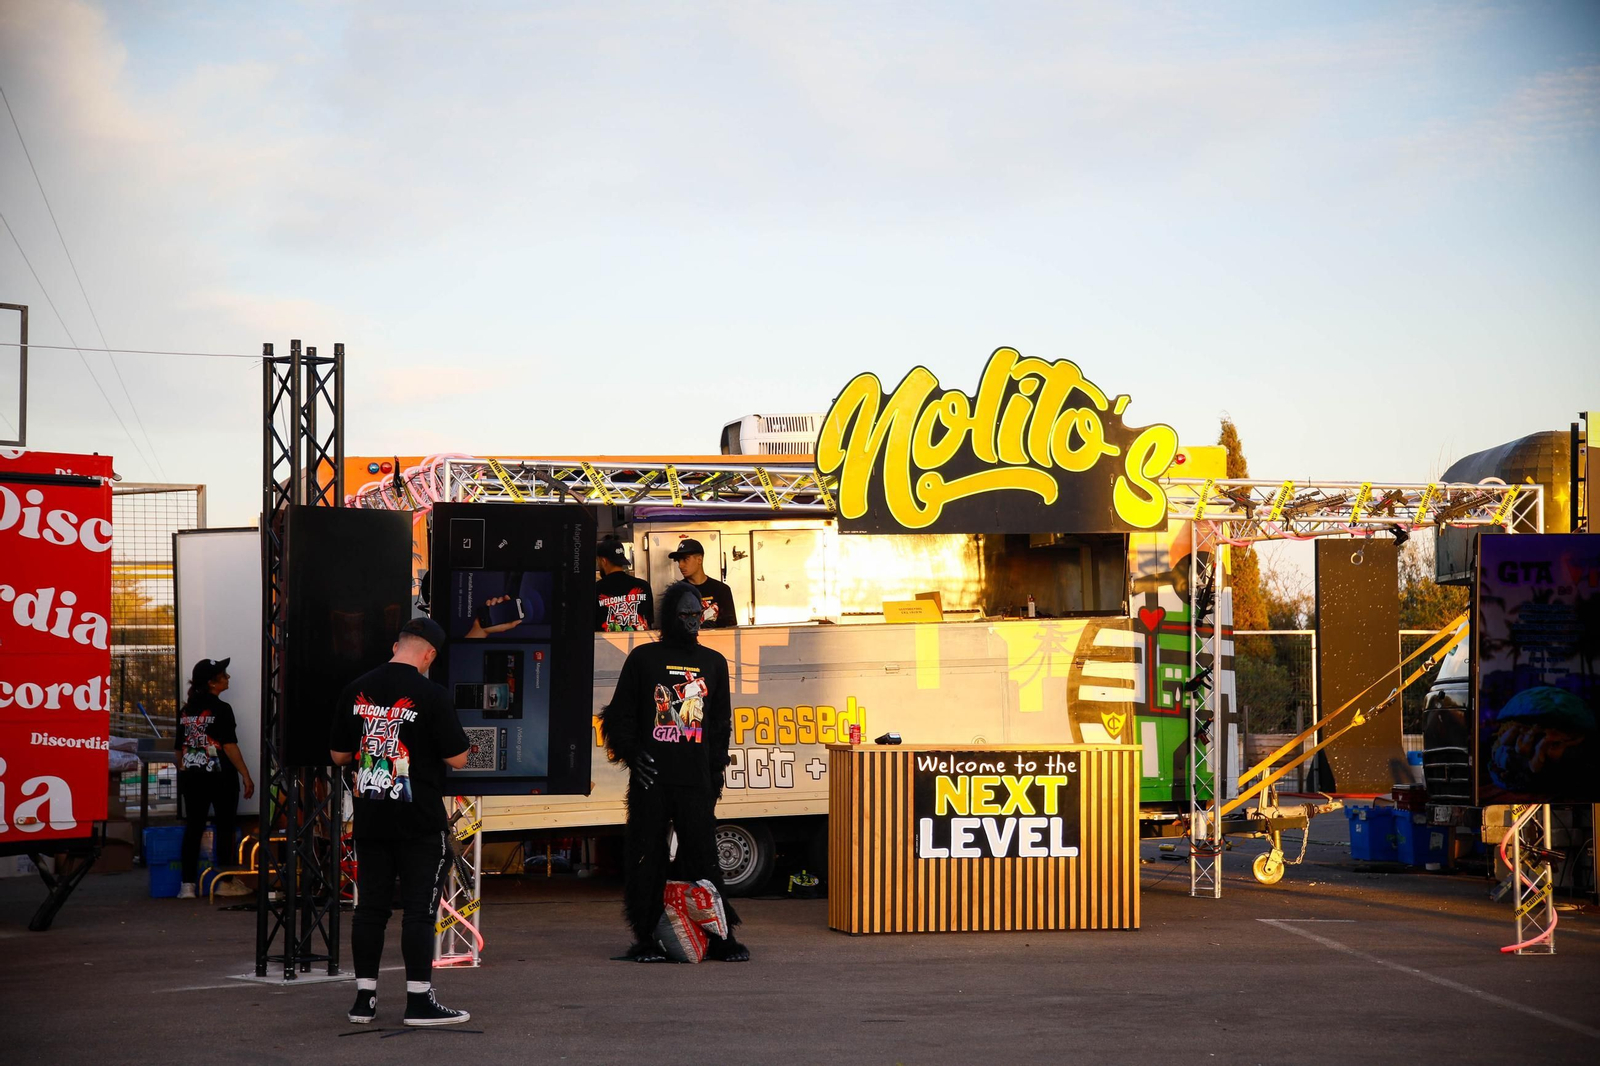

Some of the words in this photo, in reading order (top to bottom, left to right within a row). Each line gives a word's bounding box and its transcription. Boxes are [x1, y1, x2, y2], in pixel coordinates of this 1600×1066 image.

[1499, 495, 1514, 517] CAUTION
[598, 594, 627, 607] WELCOME
[637, 593, 647, 601] THE
[353, 704, 391, 718] WELCOME
[390, 706, 401, 718] TO
[400, 707, 419, 723] THE
[30, 732, 110, 751] Discordia
[653, 725, 682, 743] GTA
[917, 754, 1007, 775] Welcome
[1013, 754, 1038, 775] to
[1044, 754, 1078, 776] the
[935, 775, 1068, 816] NEXT
[919, 817, 1079, 859] LEVEL
[1525, 889, 1546, 908] CAUTION
